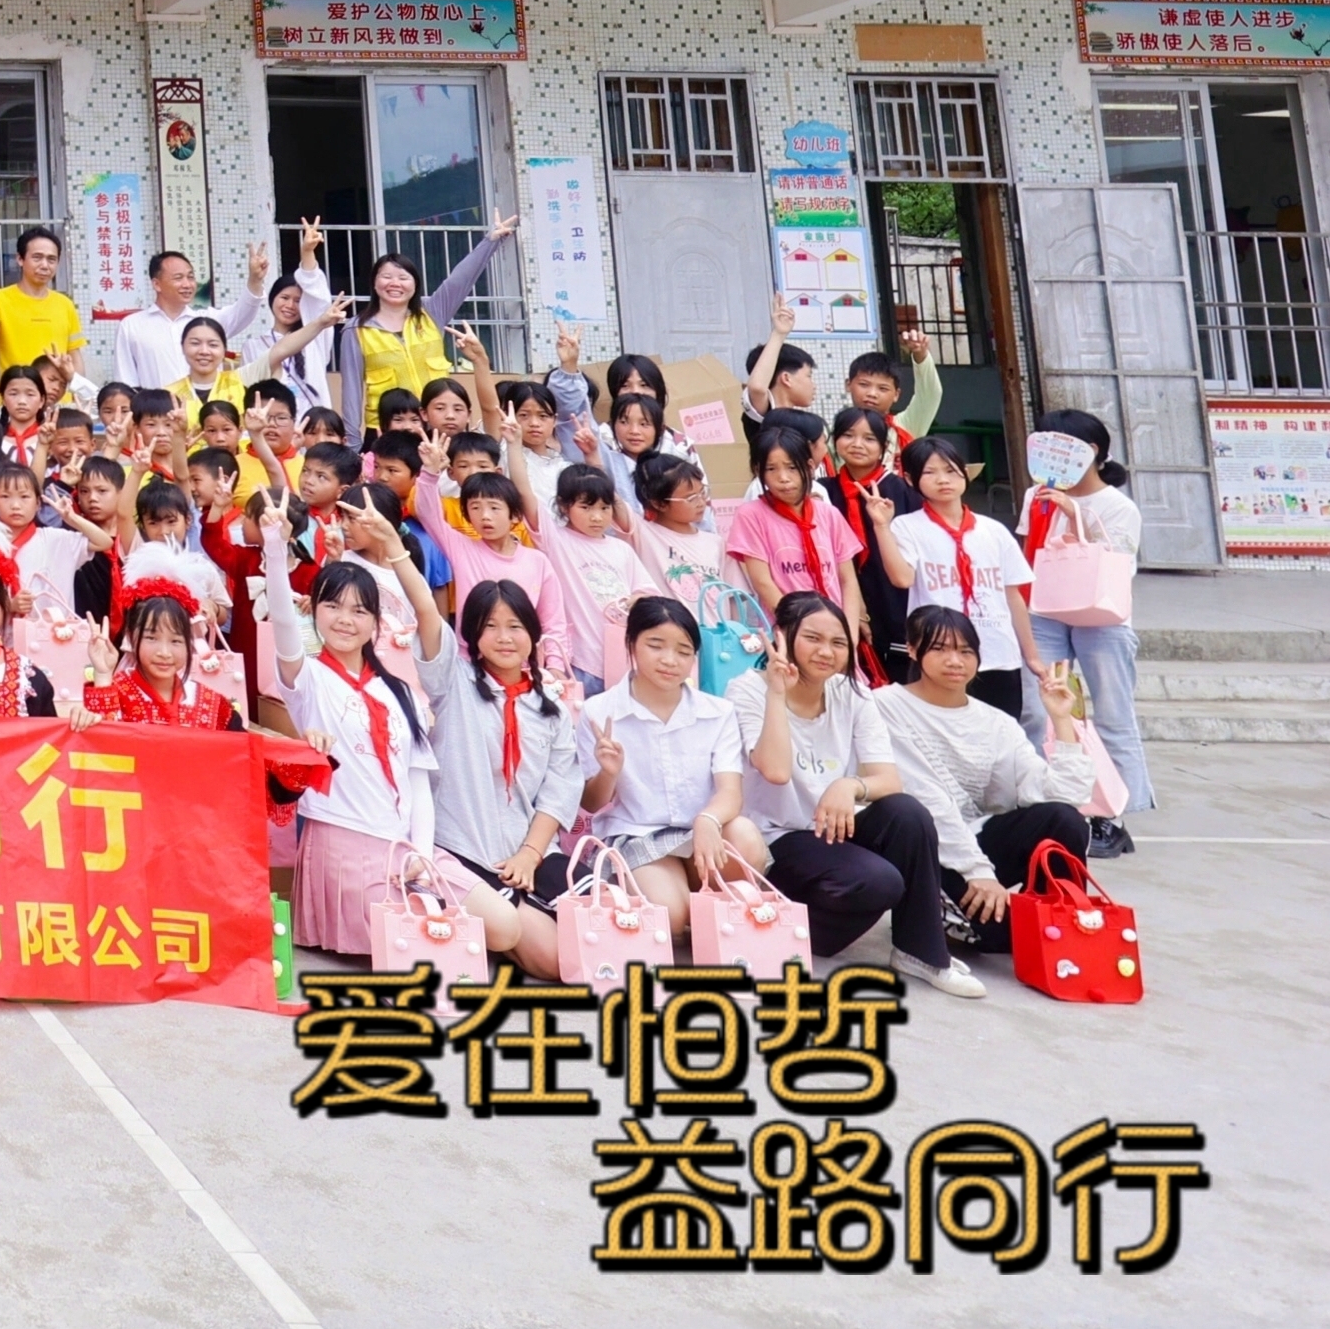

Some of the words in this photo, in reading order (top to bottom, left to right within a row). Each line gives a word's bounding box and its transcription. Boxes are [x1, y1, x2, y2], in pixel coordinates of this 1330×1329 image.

[326, 2, 498, 23] 爱护公物放心上，
[1157, 7, 1307, 30] 谦虚使人进步，
[283, 26, 456, 47] 树立新风我做到。
[1115, 32, 1266, 55] 骄傲使人落后。
[793, 136, 842, 153] 幼儿班
[777, 174, 849, 191] 请讲普通话
[779, 196, 851, 212] 请写规范字
[94, 192, 115, 292] 参与禁毒斗争
[115, 192, 135, 292] 积极行动起来
[924, 561, 1004, 593] SEAATE
